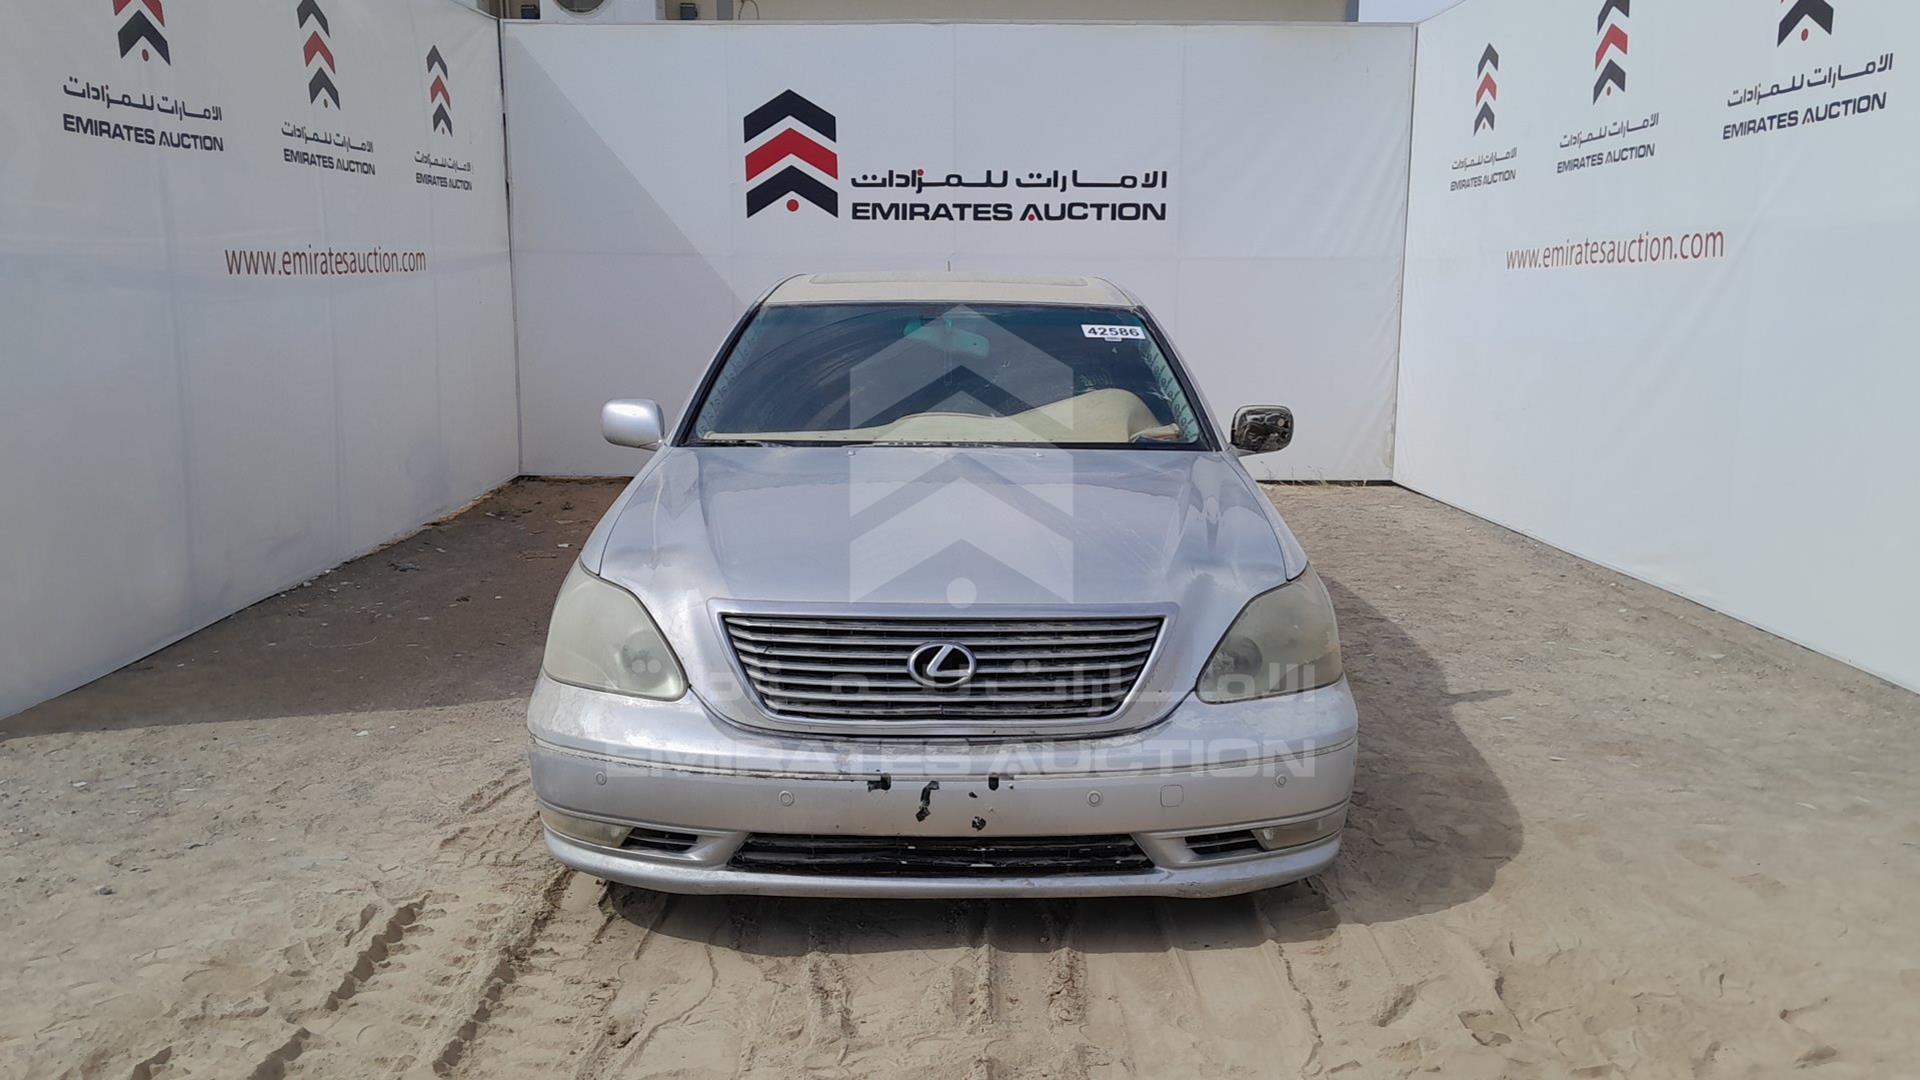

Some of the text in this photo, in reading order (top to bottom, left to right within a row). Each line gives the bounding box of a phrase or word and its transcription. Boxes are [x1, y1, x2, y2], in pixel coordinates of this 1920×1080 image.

[63, 113, 224, 151] EMIRATES AUCTION
[1723, 92, 1887, 140] EMIRATES AUCTION
[283, 148, 375, 175] EMIRATES AUCTION
[1557, 142, 1655, 174] EMIRATES AUCTION
[851, 202, 1167, 221] EMIRATES AUCTION
[225, 243, 426, 276] www.emiratesauction.com
[1506, 230, 1724, 270] www.emiratesauction.com
[1087, 327, 1140, 337] 42586
